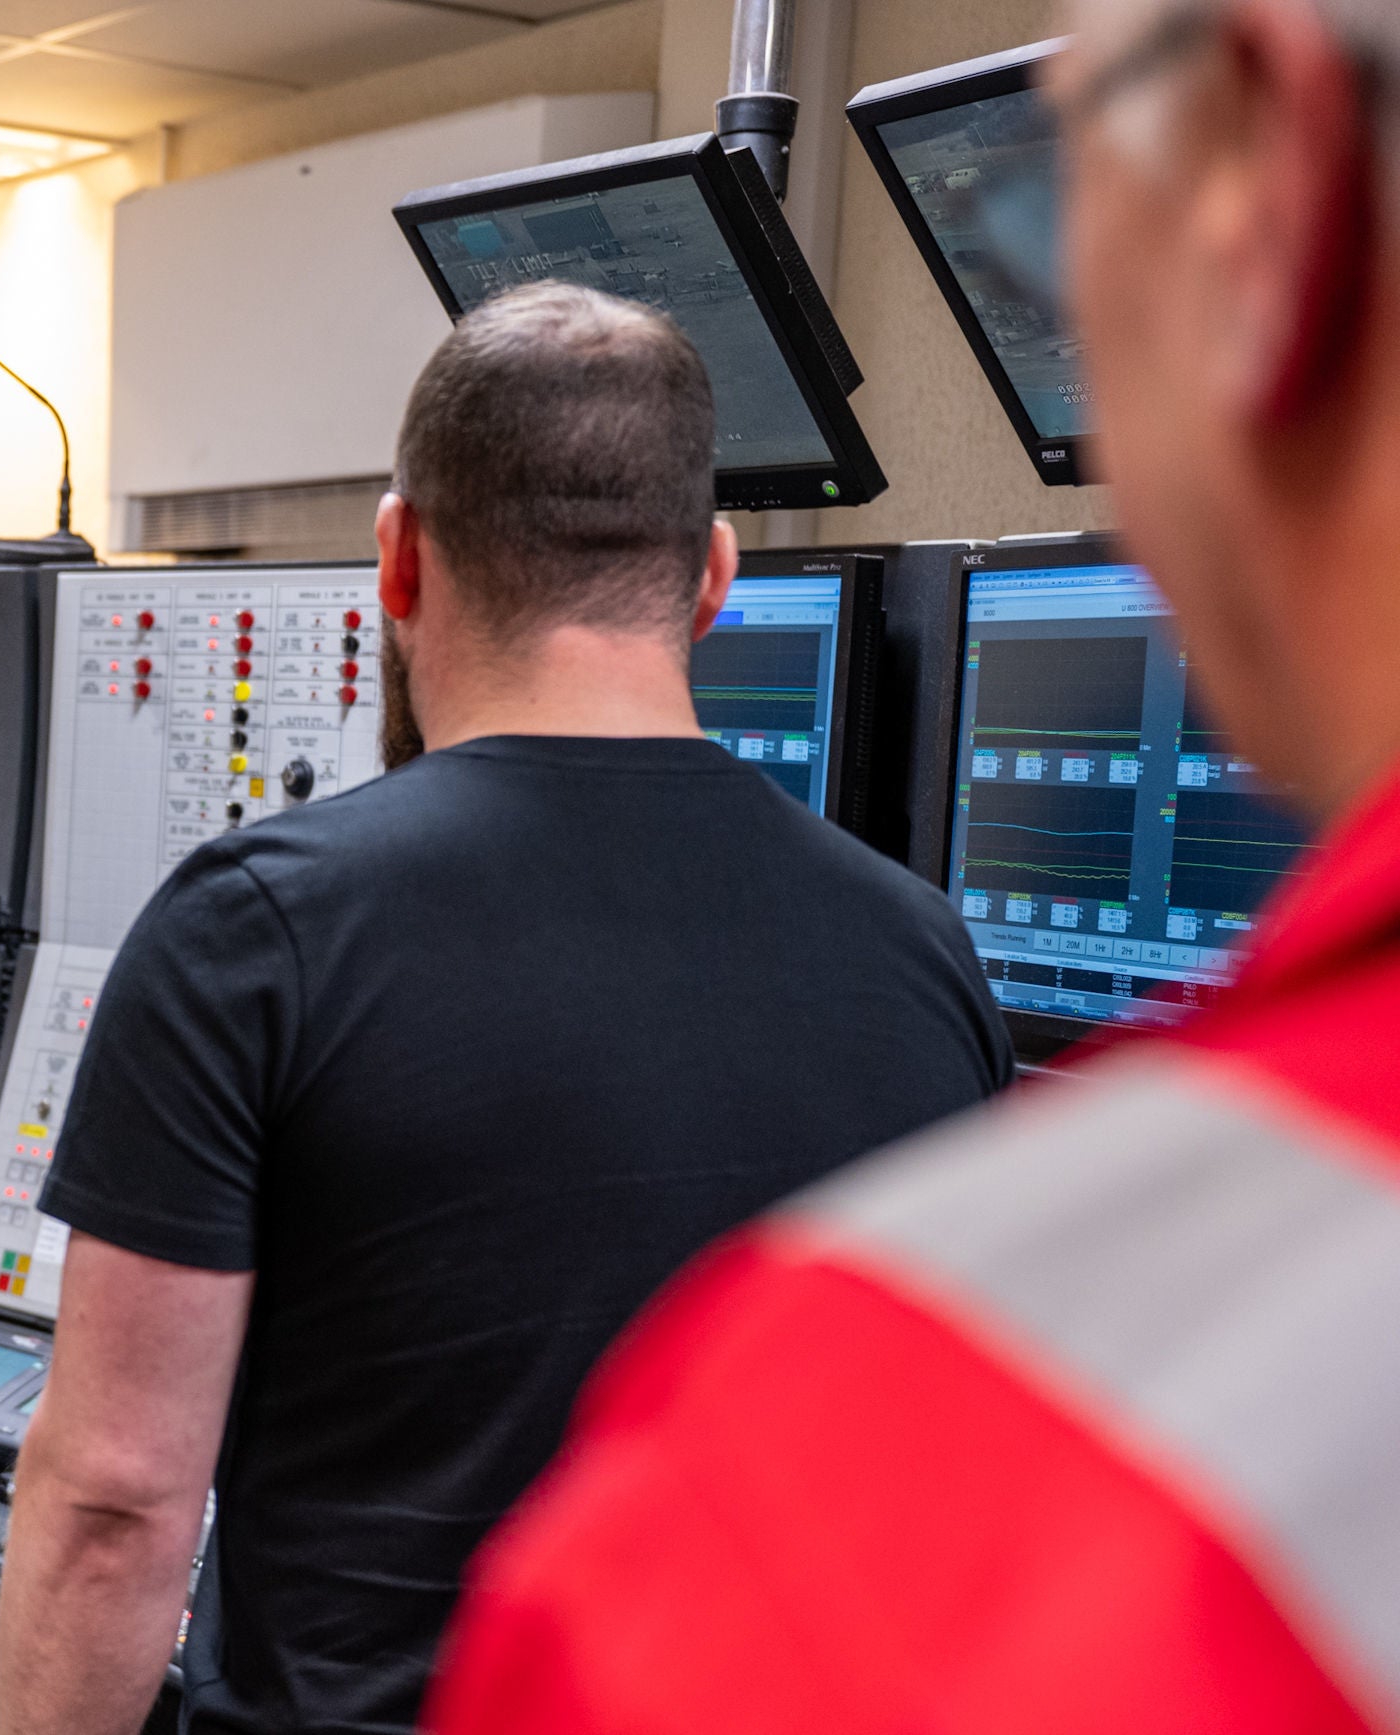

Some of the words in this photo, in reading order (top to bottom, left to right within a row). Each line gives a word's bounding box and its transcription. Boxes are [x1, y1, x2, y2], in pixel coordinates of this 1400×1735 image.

[467, 262, 499, 280] TILT
[508, 253, 554, 273] LIMIT
[1041, 450, 1066, 459] PELCO
[962, 554, 985, 565] NEC
[1043, 938, 1052, 946] 1M
[1066, 940, 1080, 950] 20M
[1095, 943, 1106, 953] 1Hr
[1121, 946, 1134, 956] 2Hr
